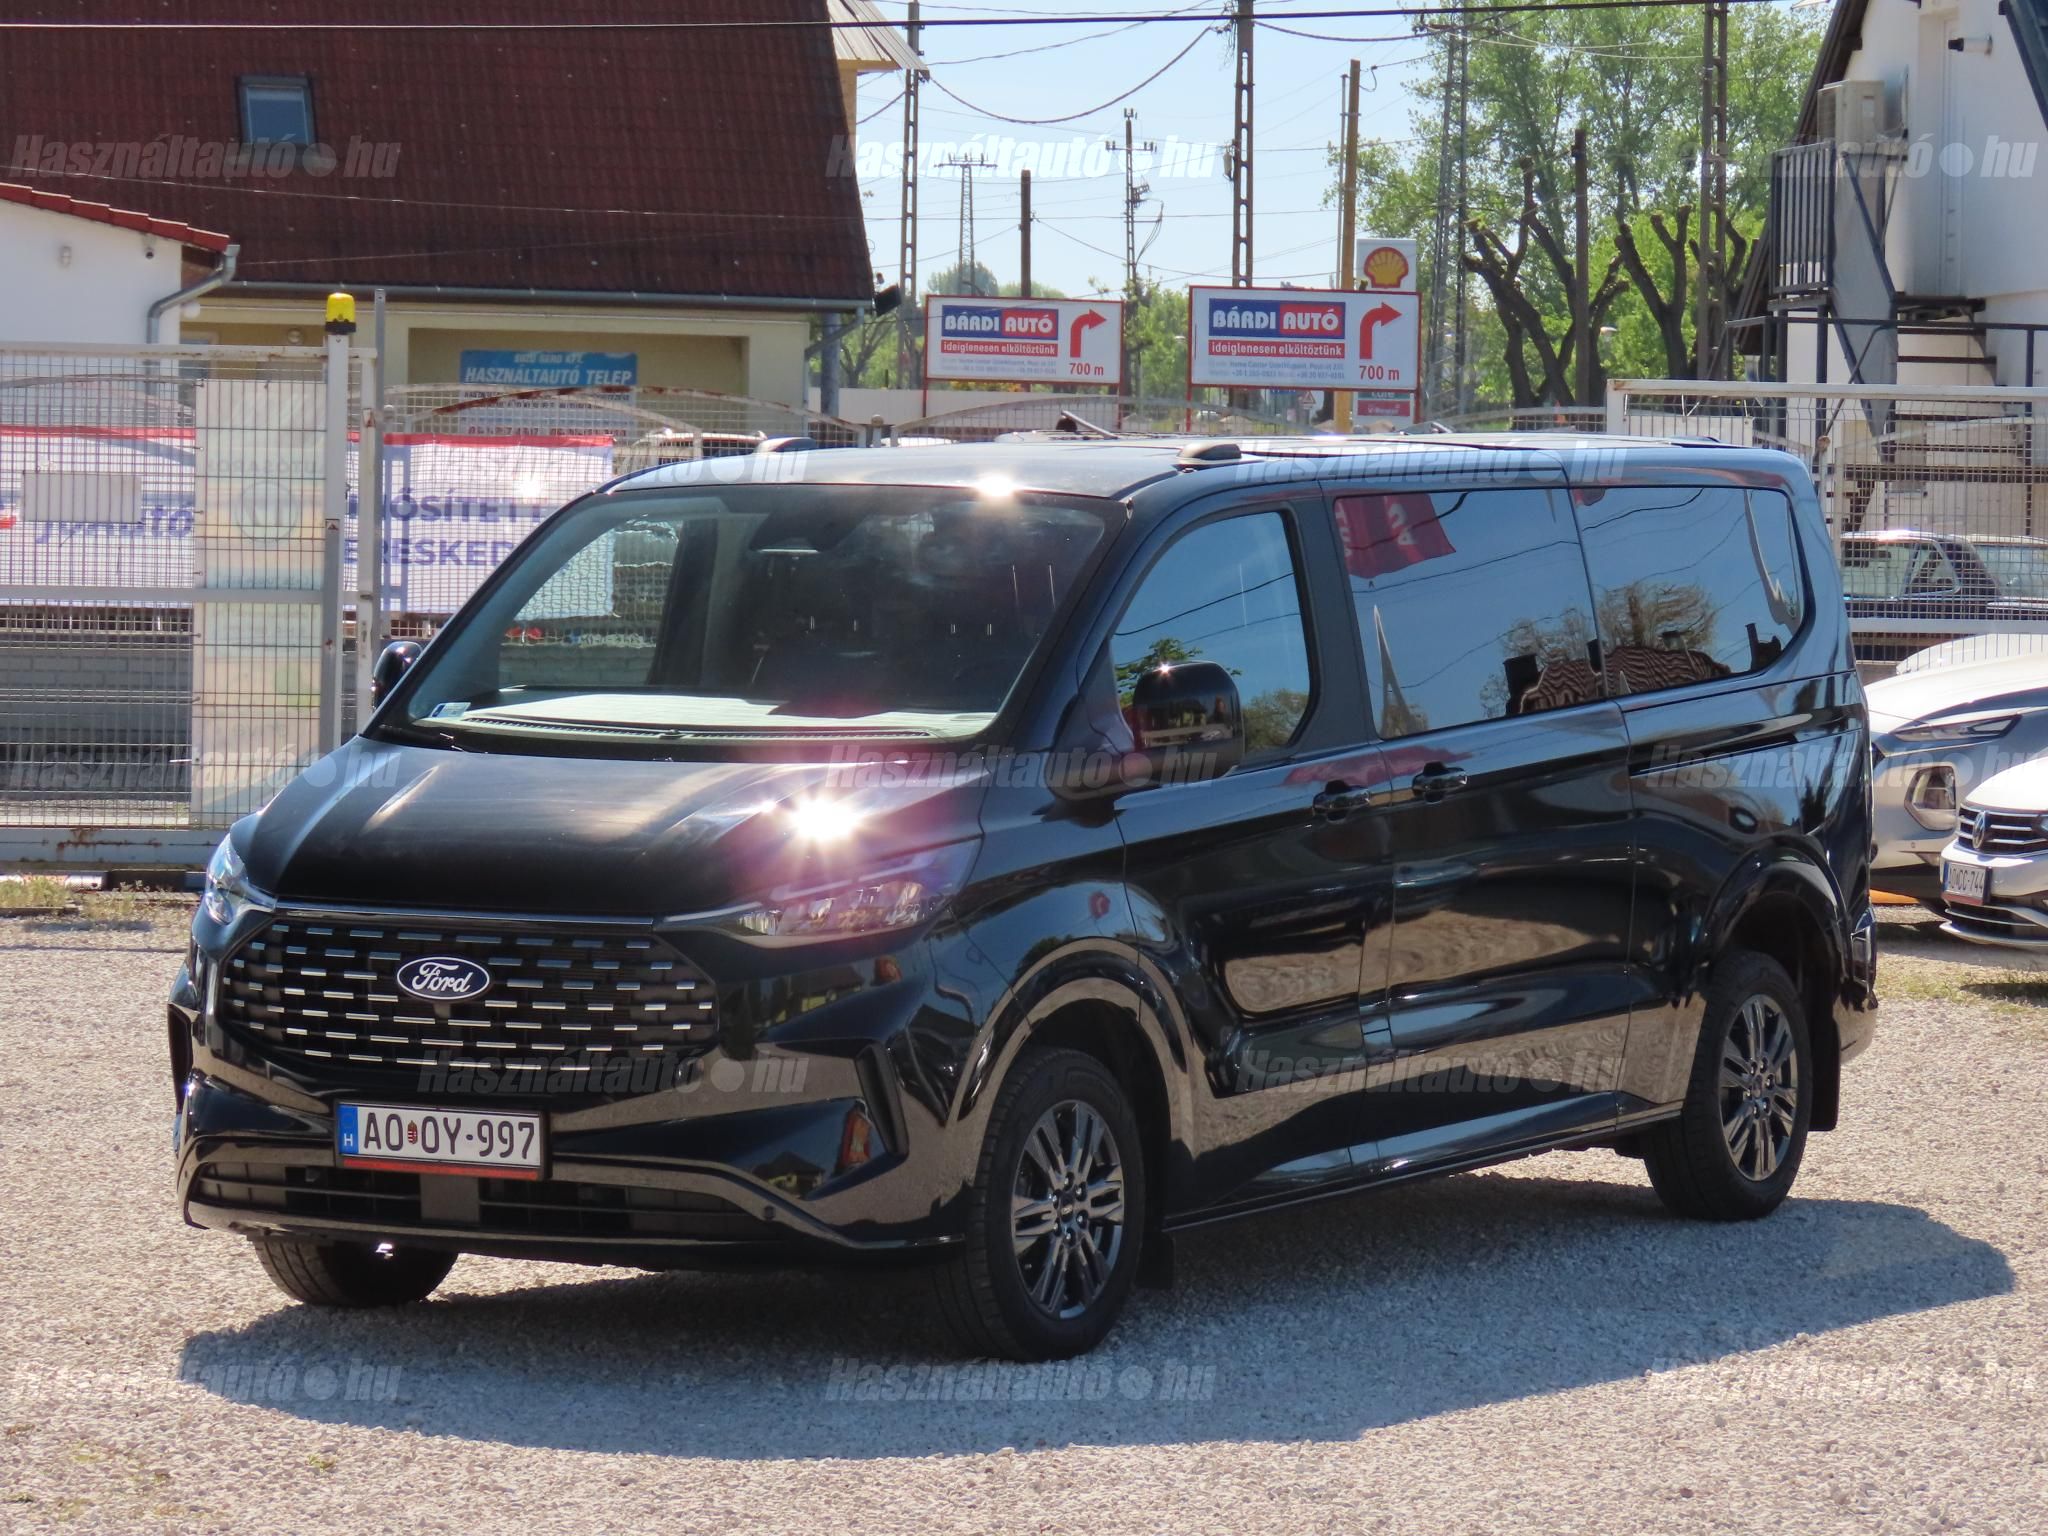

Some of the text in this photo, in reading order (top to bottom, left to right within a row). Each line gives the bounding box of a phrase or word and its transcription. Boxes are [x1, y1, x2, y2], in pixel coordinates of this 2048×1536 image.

[945, 311, 1054, 333] BÁRDI AUTÓ
[1212, 306, 1338, 330] BÁRDI AUTÓ
[943, 341, 1055, 355] ideiglenesen elköltöztünk
[1211, 342, 1342, 357] ideiglenesen elköltöztünk
[465, 364, 632, 385] HASZNÁLTAUTÓ TELEP
[1069, 362, 1091, 376] 700
[1094, 367, 1104, 376] m
[1359, 365, 1384, 380] 700
[1388, 370, 1400, 380] m
[412, 961, 472, 994] Ford
[343, 1133, 353, 1147] H
